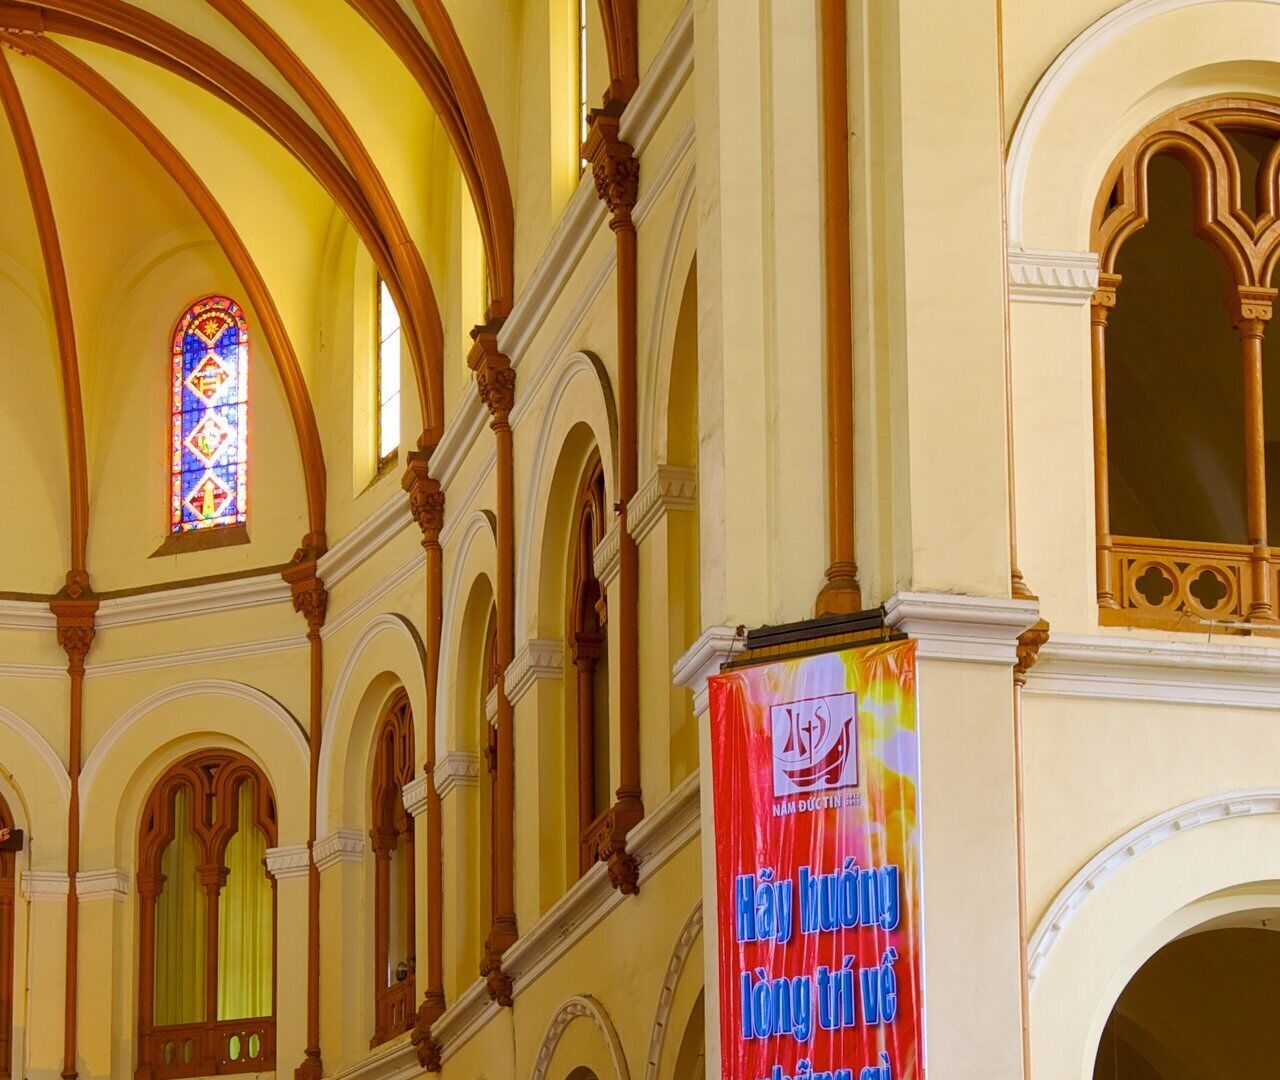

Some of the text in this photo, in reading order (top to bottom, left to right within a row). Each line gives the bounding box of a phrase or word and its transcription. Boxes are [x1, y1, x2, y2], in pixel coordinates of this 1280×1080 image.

[735, 856, 900, 943] Hãy hướng
[741, 946, 899, 1041] lòng trí về
